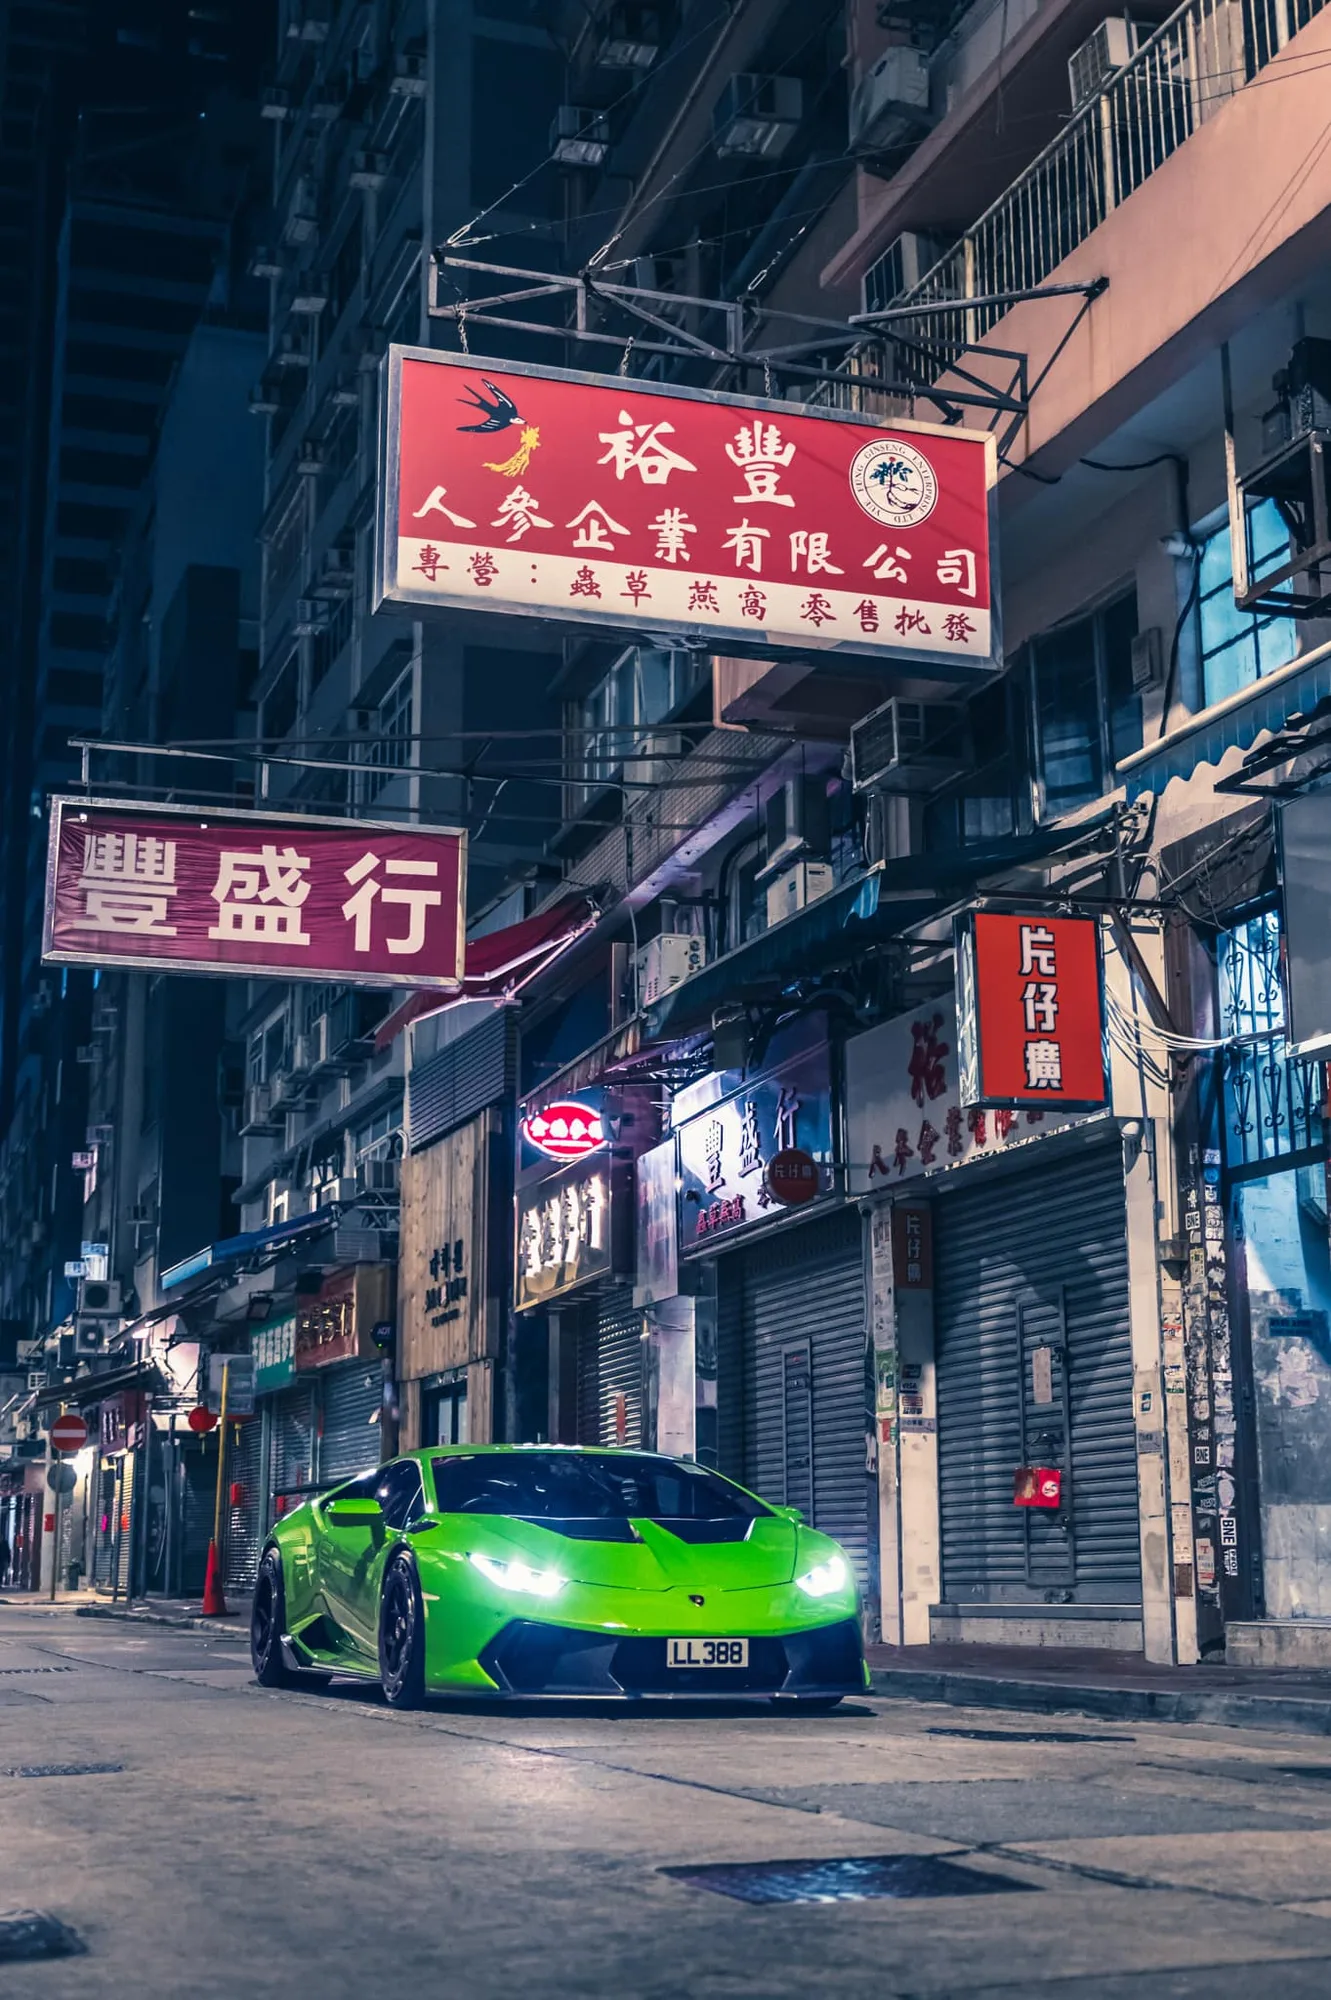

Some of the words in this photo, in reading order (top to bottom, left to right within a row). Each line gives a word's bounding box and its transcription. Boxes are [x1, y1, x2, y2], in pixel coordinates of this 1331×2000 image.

[597, 409, 796, 507] 裕豐
[864, 443, 906, 459] GINSENG
[912, 455, 933, 515] ENTERPRISE
[893, 513, 914, 523] LTD
[412, 484, 977, 598] 人參企業有限公司
[73, 833, 441, 954] 豐盛行
[1019, 925, 1063, 1090] 片仔癀
[1196, 1448, 1209, 1462] BNE
[1222, 1520, 1235, 1544] BNE
[673, 1641, 743, 1665] LL388
